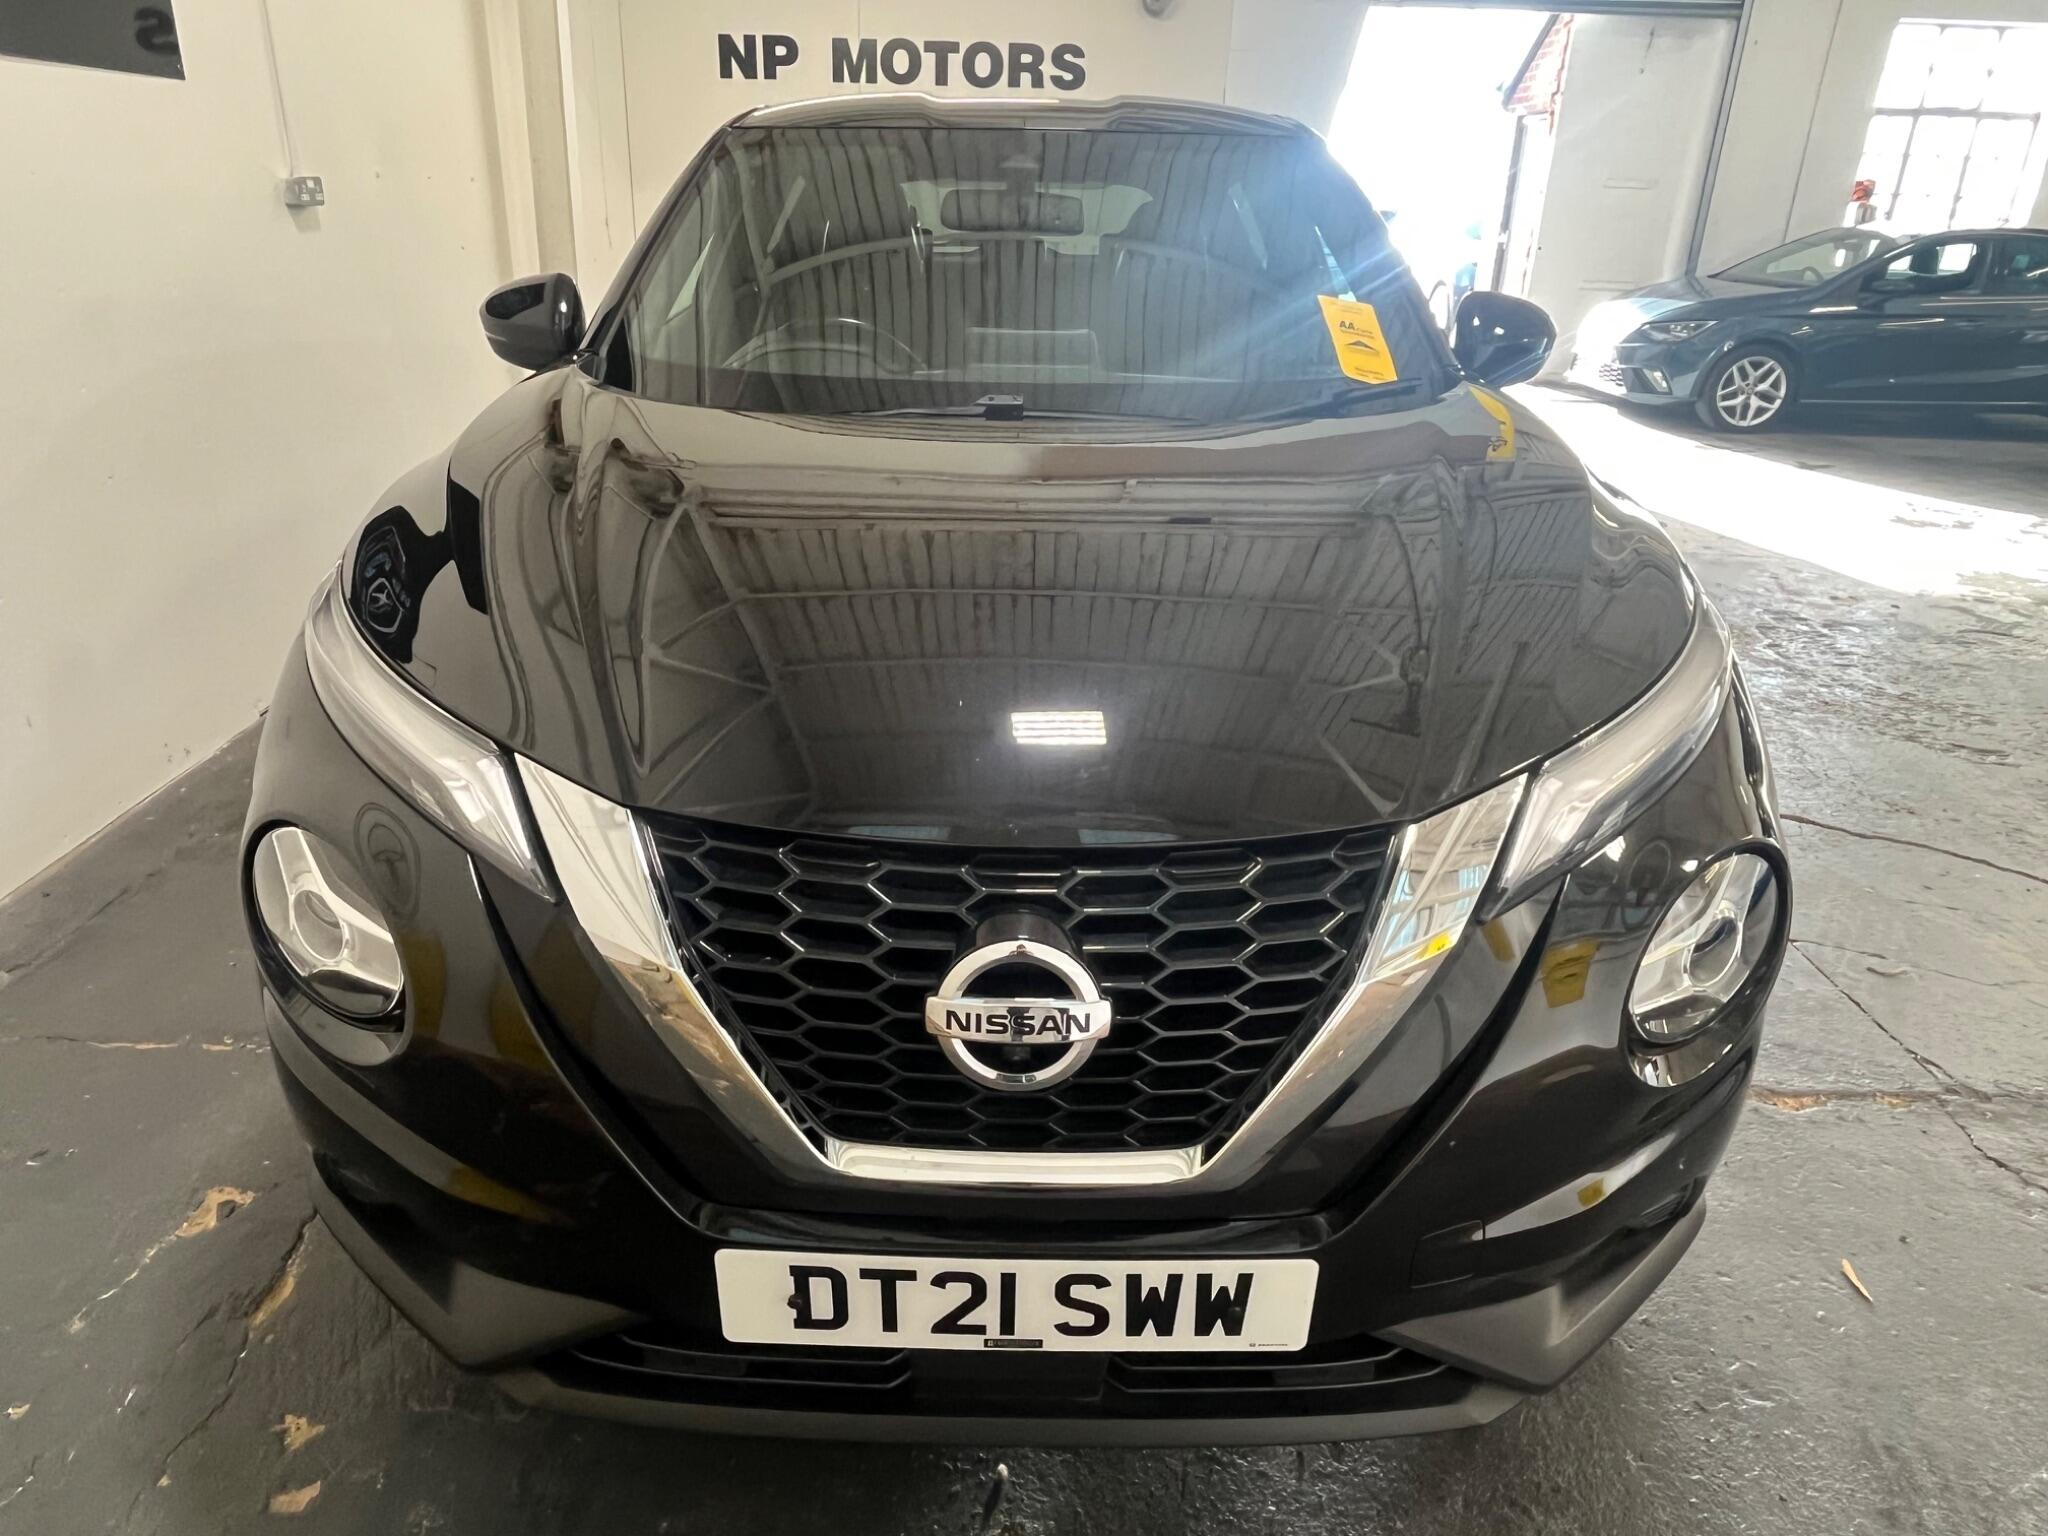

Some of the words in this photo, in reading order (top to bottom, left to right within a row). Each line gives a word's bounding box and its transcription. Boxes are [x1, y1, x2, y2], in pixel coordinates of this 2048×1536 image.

[718, 34, 799, 80] NP
[832, 38, 1086, 90] MOTORS
[1339, 320, 1355, 331] AA
[946, 1010, 1091, 1035] NISSAN
[787, 1265, 1017, 1337] DT21
[1054, 1273, 1254, 1337] SWW
